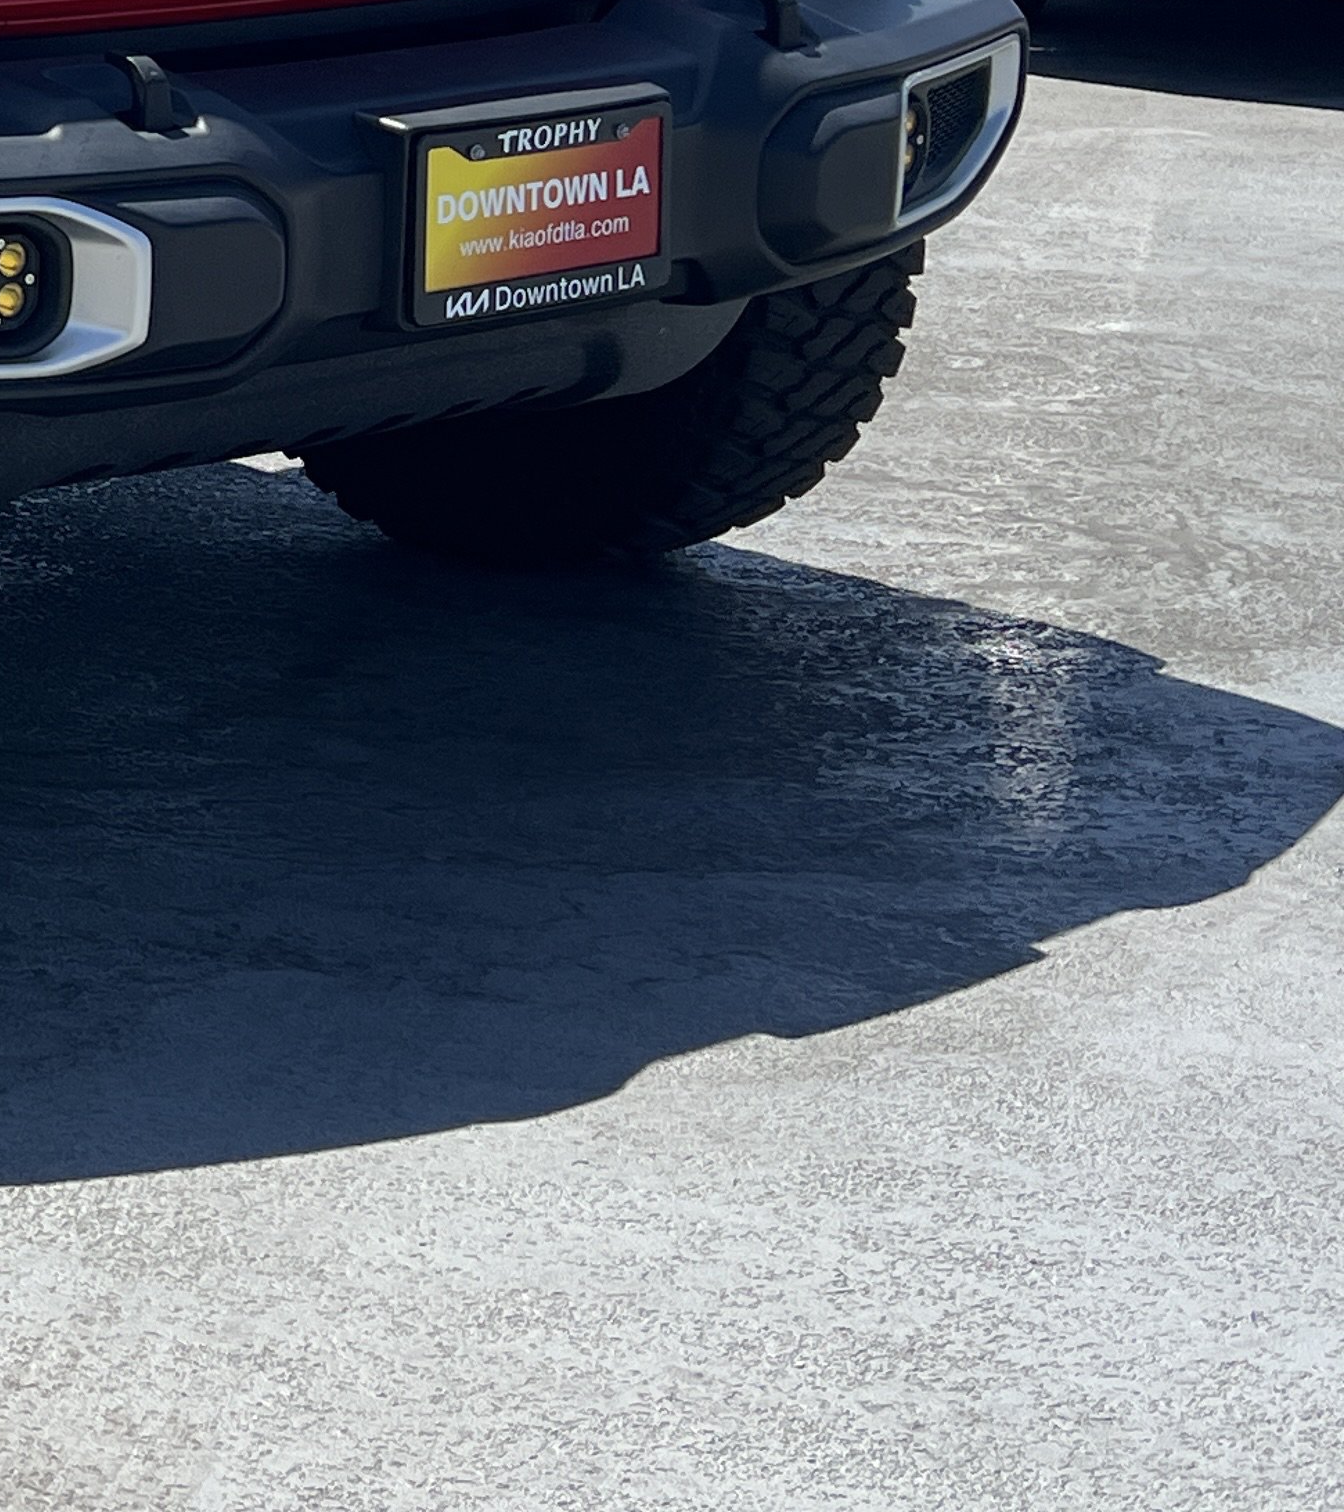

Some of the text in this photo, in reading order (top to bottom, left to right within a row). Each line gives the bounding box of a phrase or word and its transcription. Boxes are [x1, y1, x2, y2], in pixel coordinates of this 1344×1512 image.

[498, 117, 602, 154] TROPHY
[436, 165, 651, 225] DOWNTOWN LA
[459, 215, 630, 257] www.kiaofdtla.com
[444, 263, 646, 319] KIA Downtown LA
